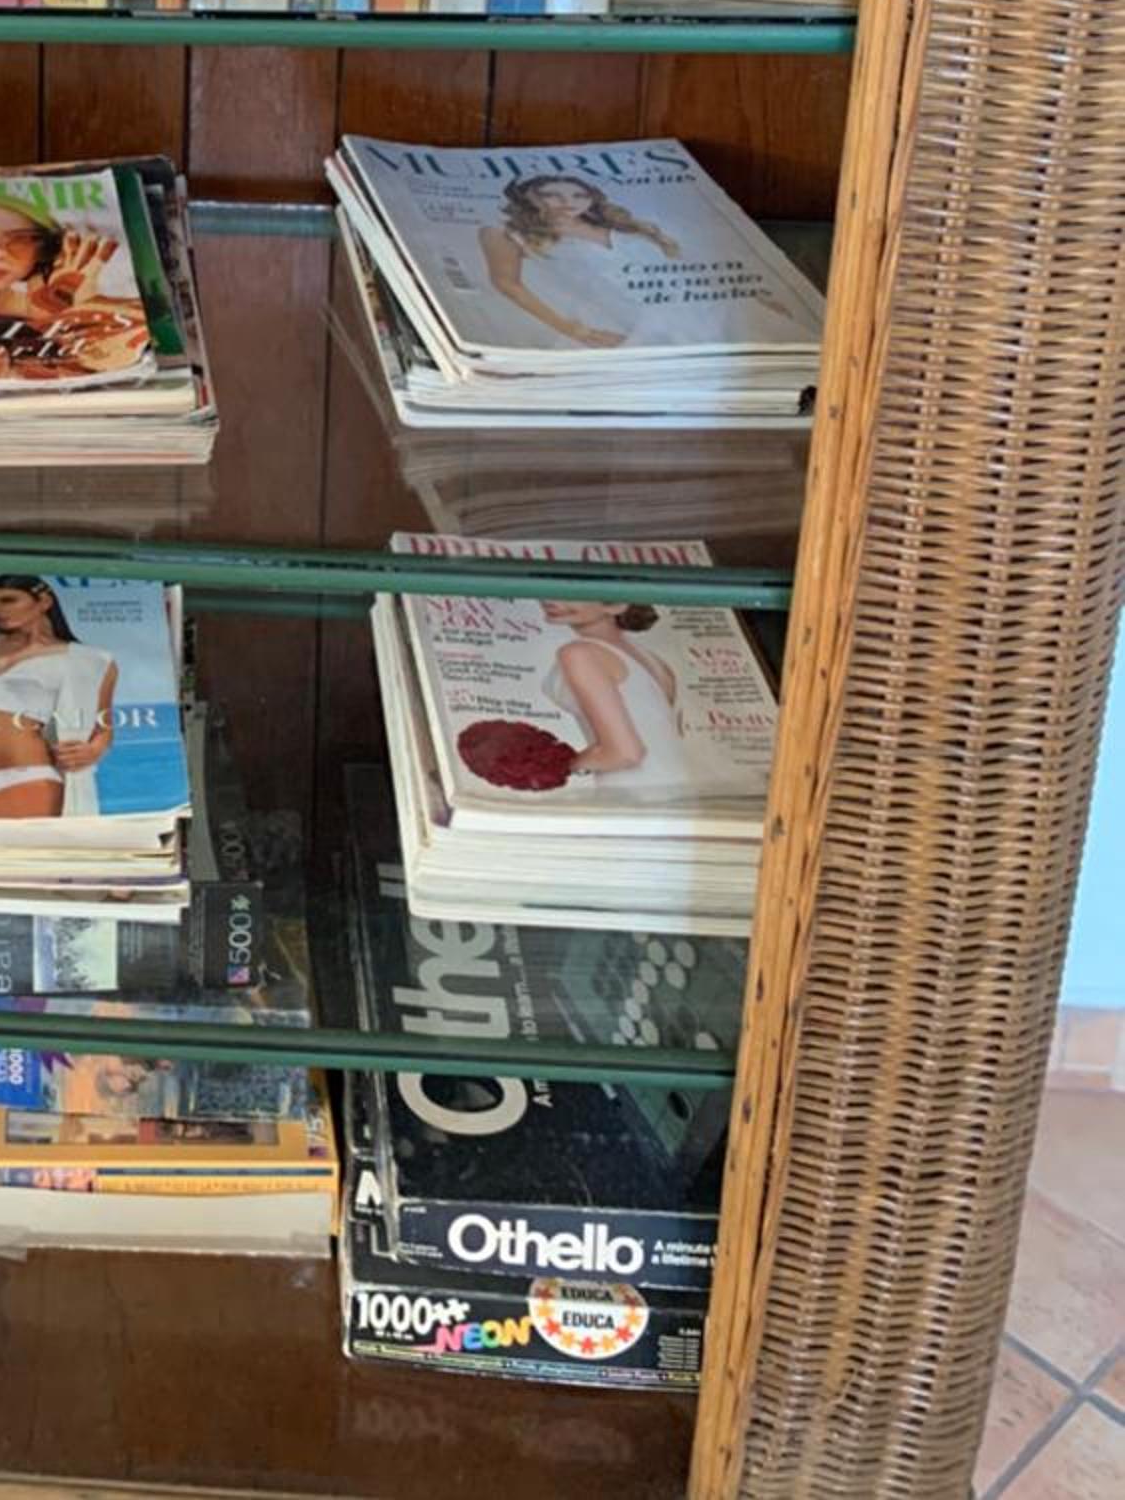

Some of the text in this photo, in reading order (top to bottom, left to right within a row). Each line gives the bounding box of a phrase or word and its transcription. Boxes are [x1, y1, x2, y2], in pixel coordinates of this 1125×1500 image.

[366, 145, 691, 179] MUJERES
[447, 1212, 644, 1276] Othello
[560, 1286, 613, 1303] EDUCA
[355, 1291, 430, 1336] 1000
[561, 1310, 615, 1330] EDUCA
[435, 1314, 539, 1353] NEON
